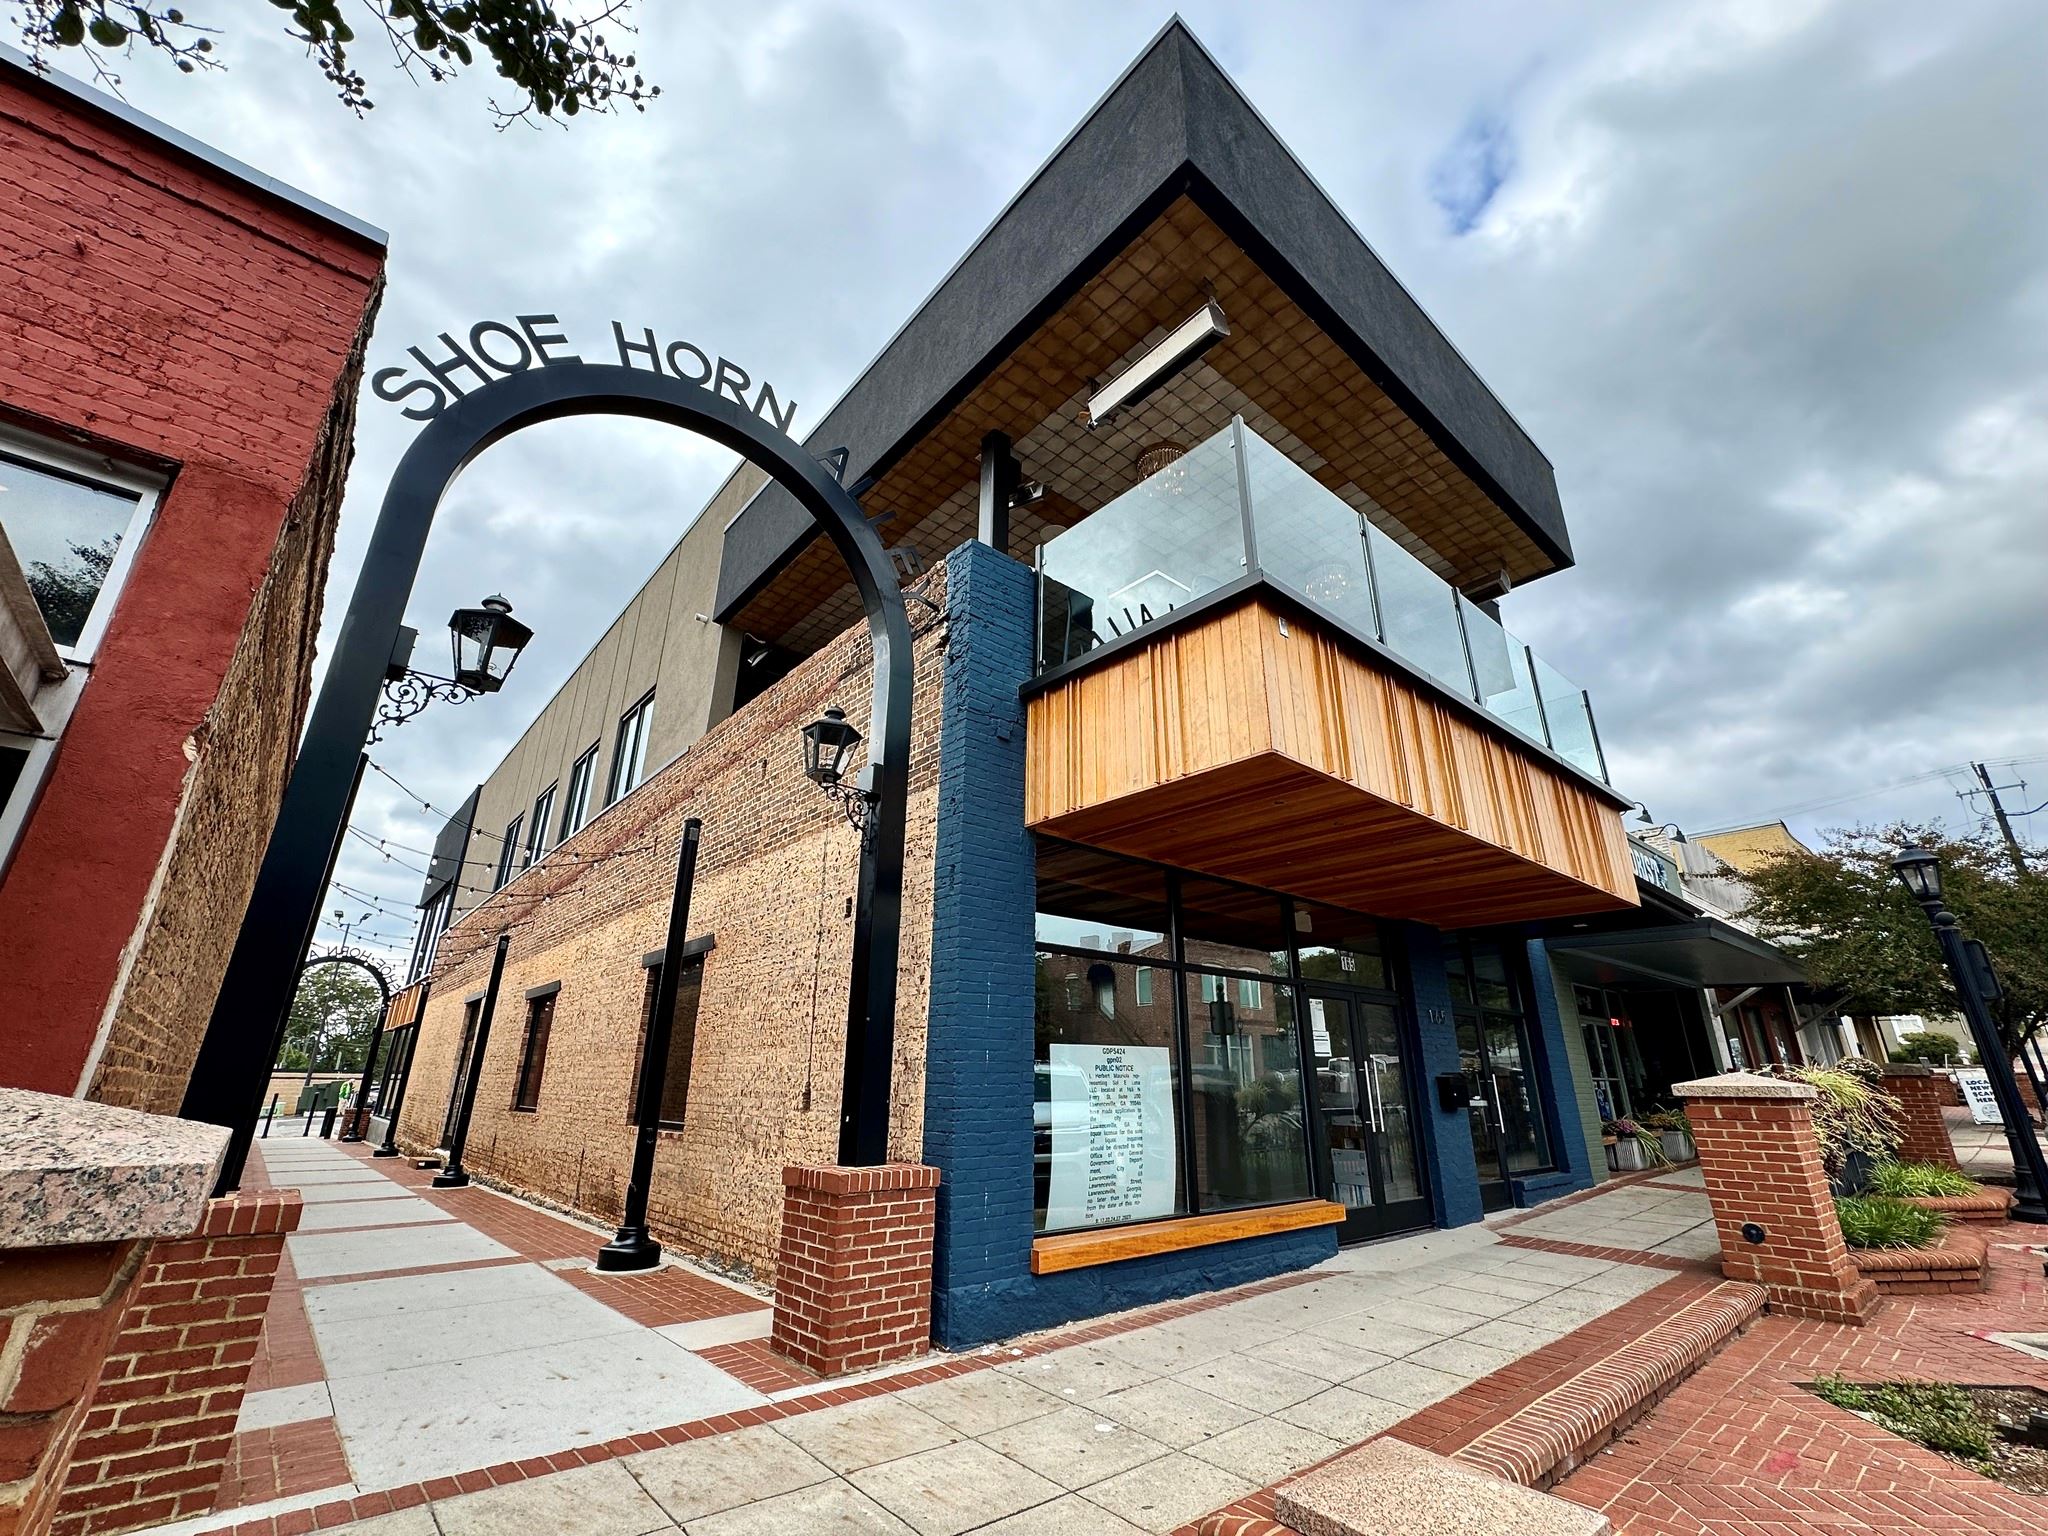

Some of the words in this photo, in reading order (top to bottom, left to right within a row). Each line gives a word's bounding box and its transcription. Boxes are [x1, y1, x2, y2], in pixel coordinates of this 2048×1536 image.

[372, 314, 583, 421] SHOE
[611, 320, 798, 436] HORN
[812, 446, 943, 613] ALLEY
